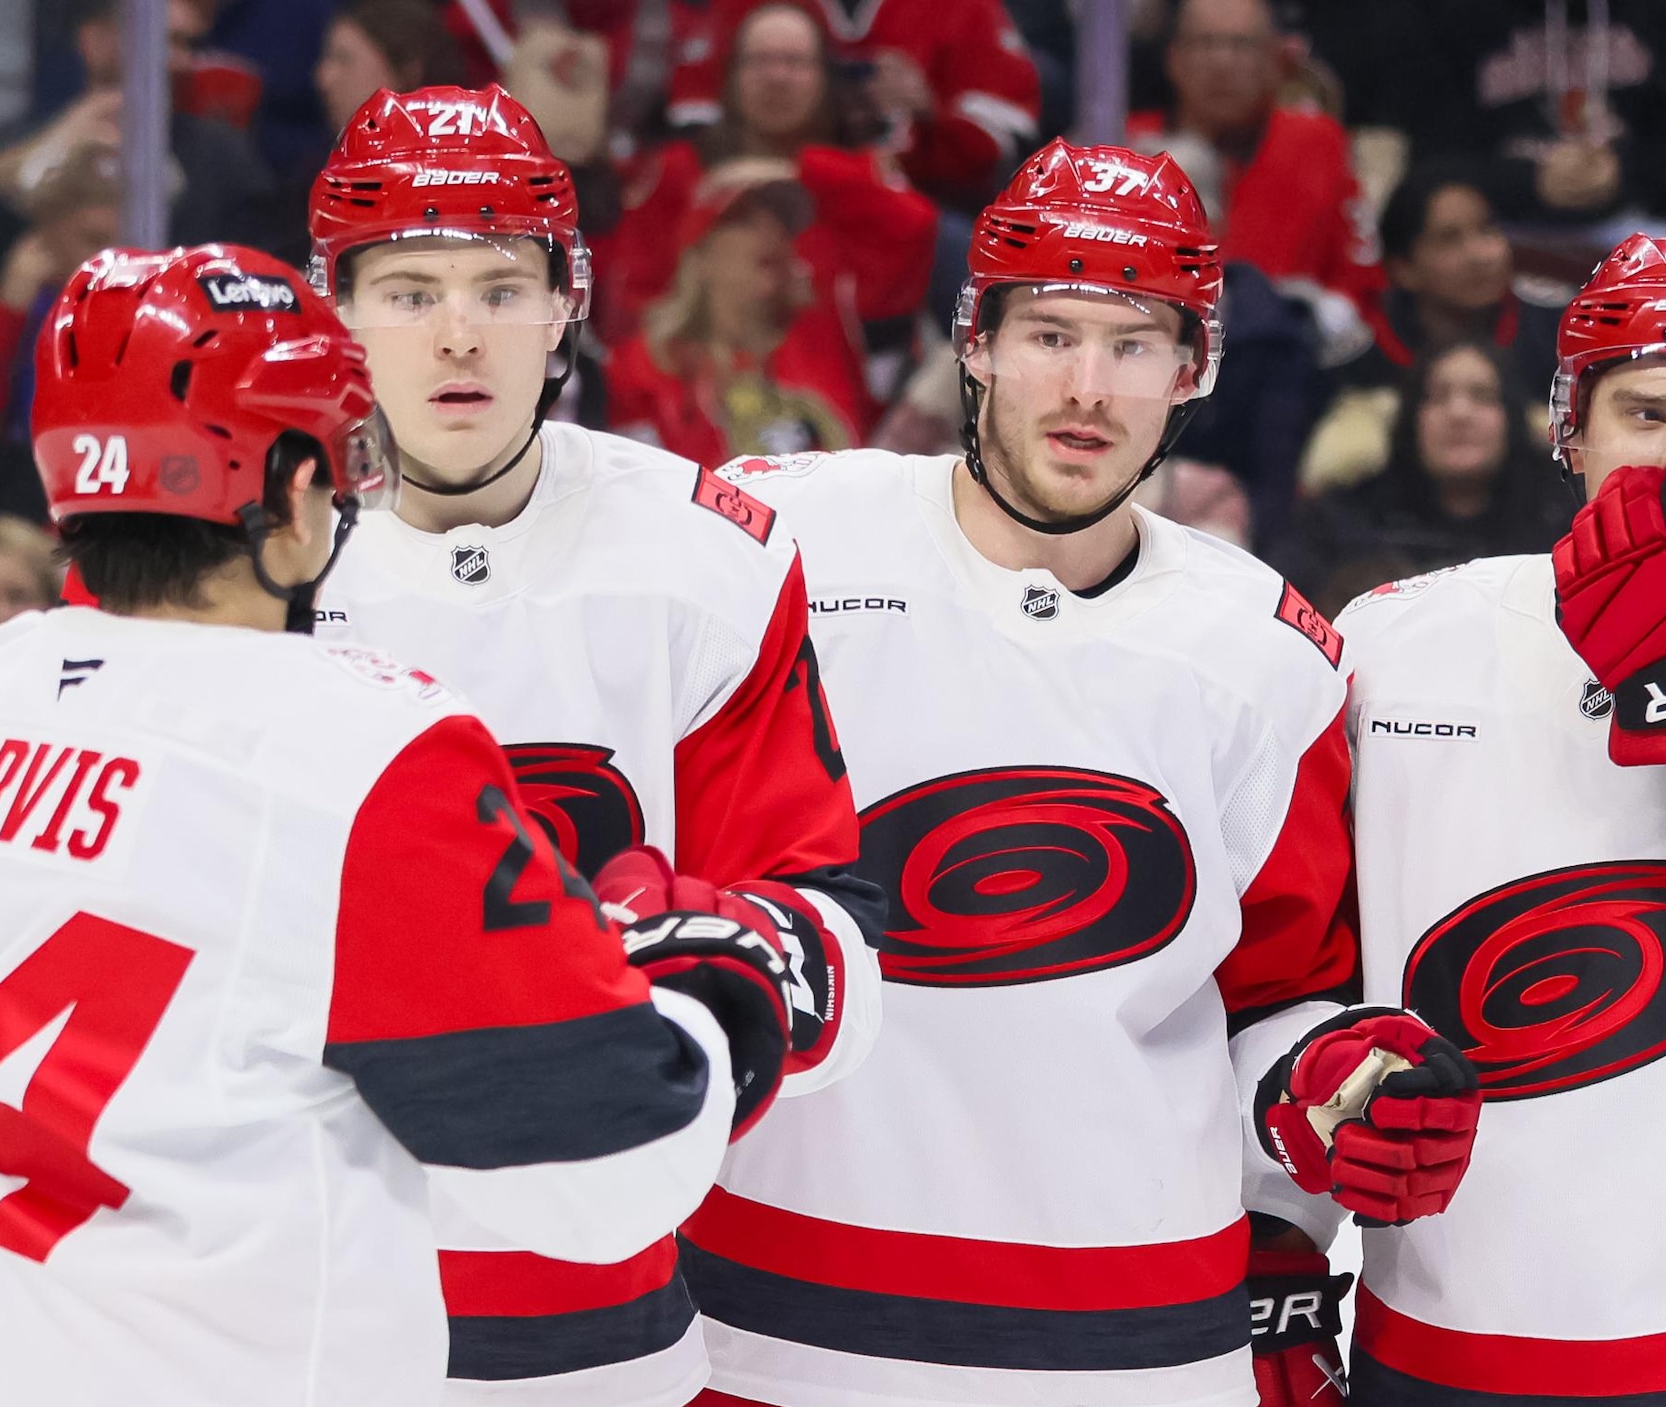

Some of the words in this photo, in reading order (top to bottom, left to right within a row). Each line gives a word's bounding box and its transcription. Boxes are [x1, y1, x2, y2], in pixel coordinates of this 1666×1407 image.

[412, 170, 500, 188] BAUER
[1084, 160, 1149, 196] 37
[1063, 222, 1148, 247] BAUER
[208, 278, 295, 308] Lenovo
[73, 434, 131, 494] 24
[1371, 720, 1477, 738] NUCOR
